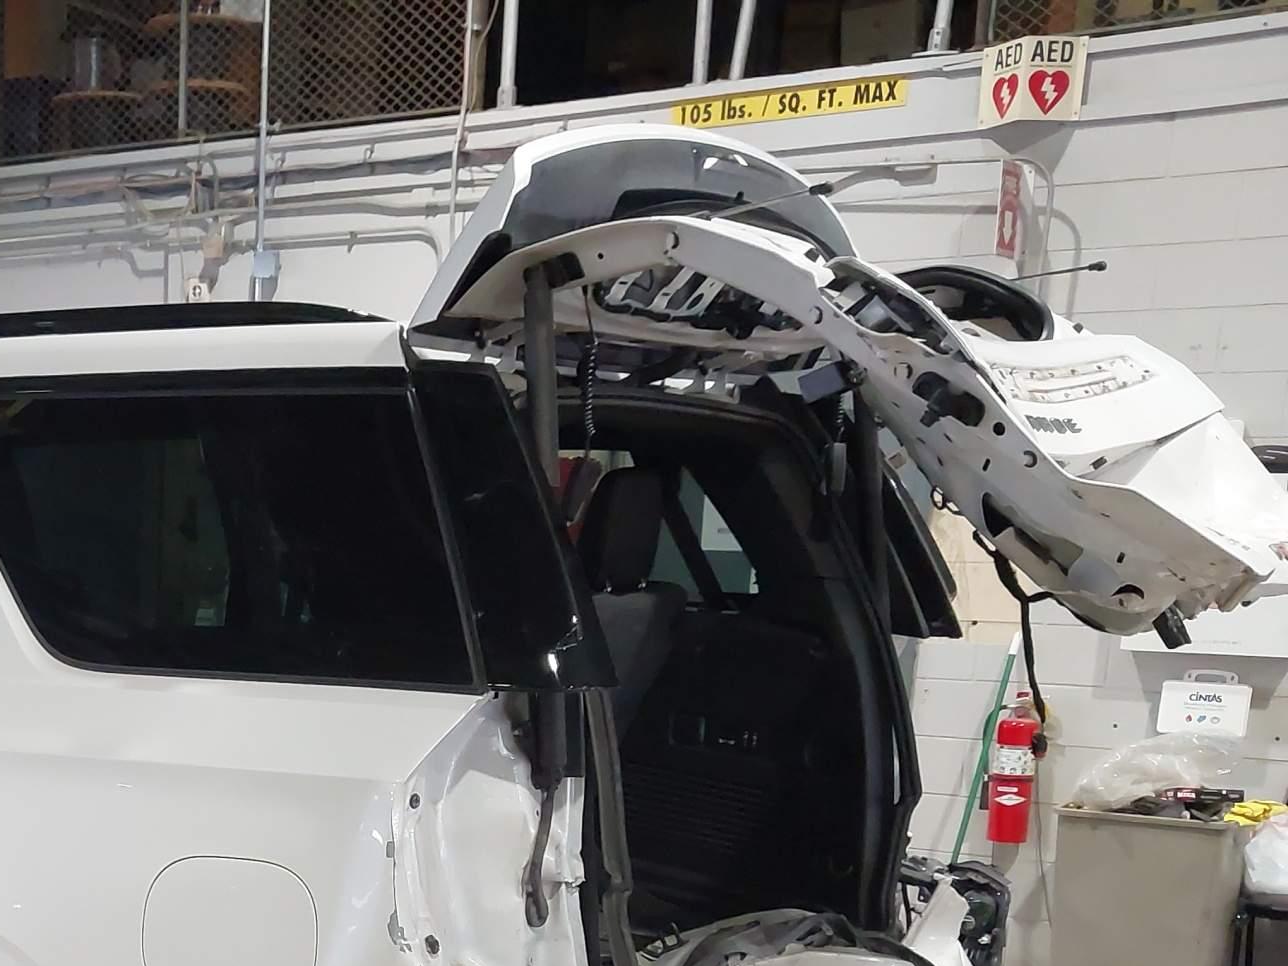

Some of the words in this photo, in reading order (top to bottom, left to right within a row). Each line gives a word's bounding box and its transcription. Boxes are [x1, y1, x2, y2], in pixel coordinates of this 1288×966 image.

[995, 43, 1023, 71] AED
[1031, 40, 1074, 62] AED
[680, 104, 712, 126] 105
[720, 99, 752, 121] lbs.
[762, 95, 770, 117] /
[778, 93, 807, 114] SQ.
[817, 88, 843, 109] FT.
[853, 79, 899, 105] MAX
